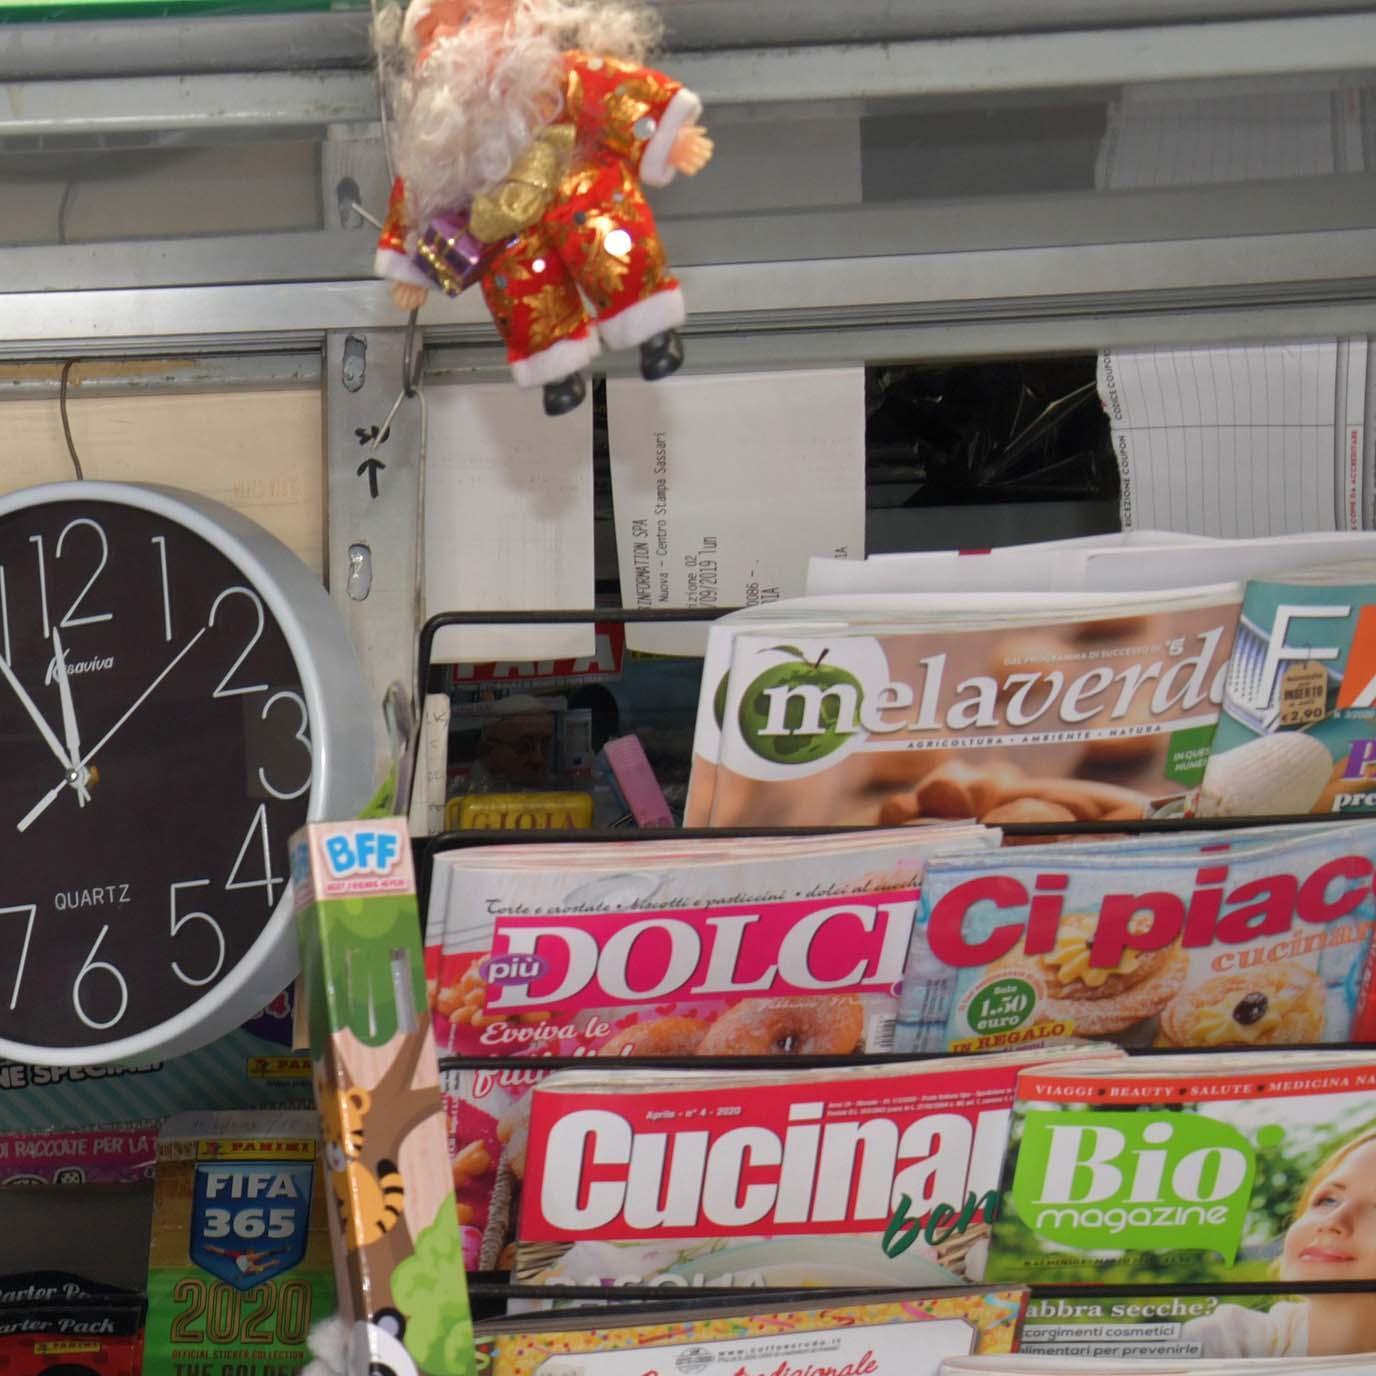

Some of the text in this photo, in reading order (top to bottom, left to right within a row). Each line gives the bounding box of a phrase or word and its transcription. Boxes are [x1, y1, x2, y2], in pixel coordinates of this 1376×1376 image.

[29, 518, 113, 638] 12
[151, 536, 173, 642] 1
[208, 586, 269, 700] 2
[258, 690, 312, 800] 3
[906, 723, 1162, 750] AGRICOLTURA AMBIENTE NATURA
[224, 803, 284, 907] 4
[326, 828, 399, 875] BFF
[53, 882, 131, 912] QUARTZ
[169, 879, 226, 986] 5
[73, 924, 128, 1029] 6
[486, 900, 921, 1009] più DOLCI
[205, 1172, 298, 1199] FIFA
[1033, 1121, 1248, 1205] Bio
[202, 1208, 296, 1238] 365
[1036, 1205, 1229, 1234] magazine
[57, 1317, 115, 1334] Pack
[170, 1279, 313, 1346] 2020
